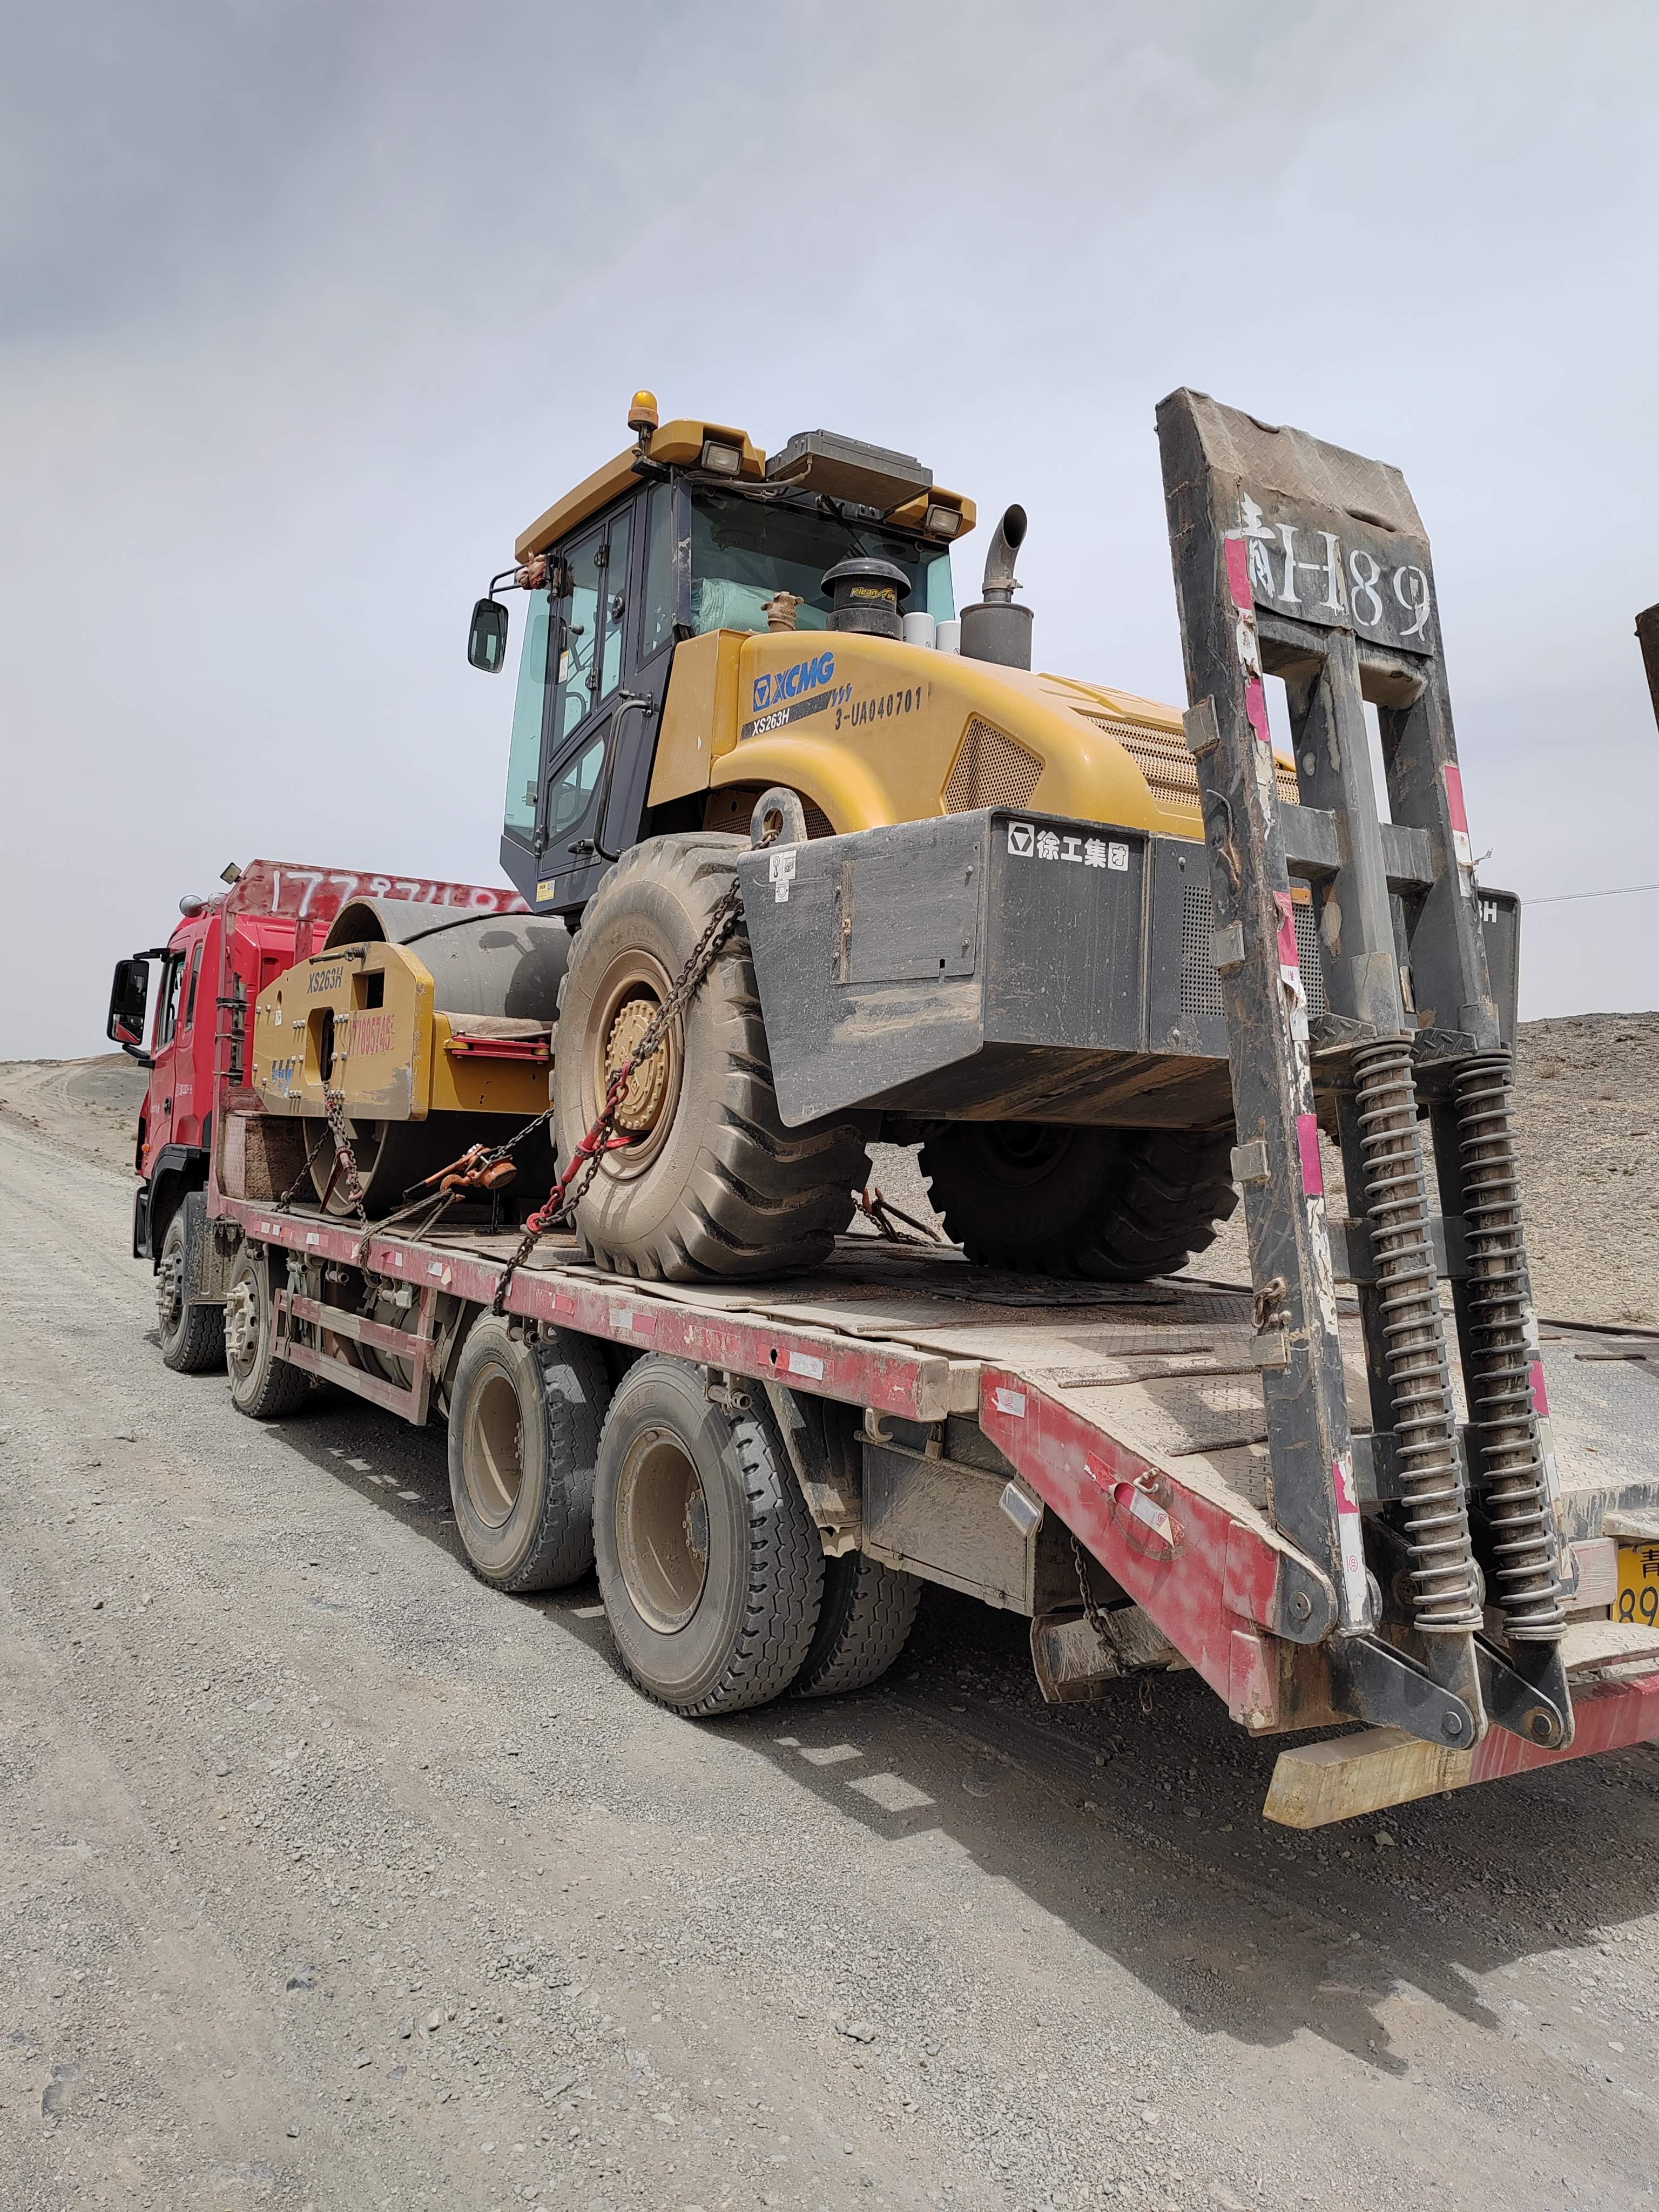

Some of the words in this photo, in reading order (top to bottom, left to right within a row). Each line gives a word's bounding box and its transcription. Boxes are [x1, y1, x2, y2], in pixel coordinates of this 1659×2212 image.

[771, 651, 835, 704] XCMG
[752, 708, 790, 736] XS263H
[1036, 830, 1129, 871] 徐工集团
[307, 966, 344, 994] XS263H
[1289, 970, 1294, 981] 3M
